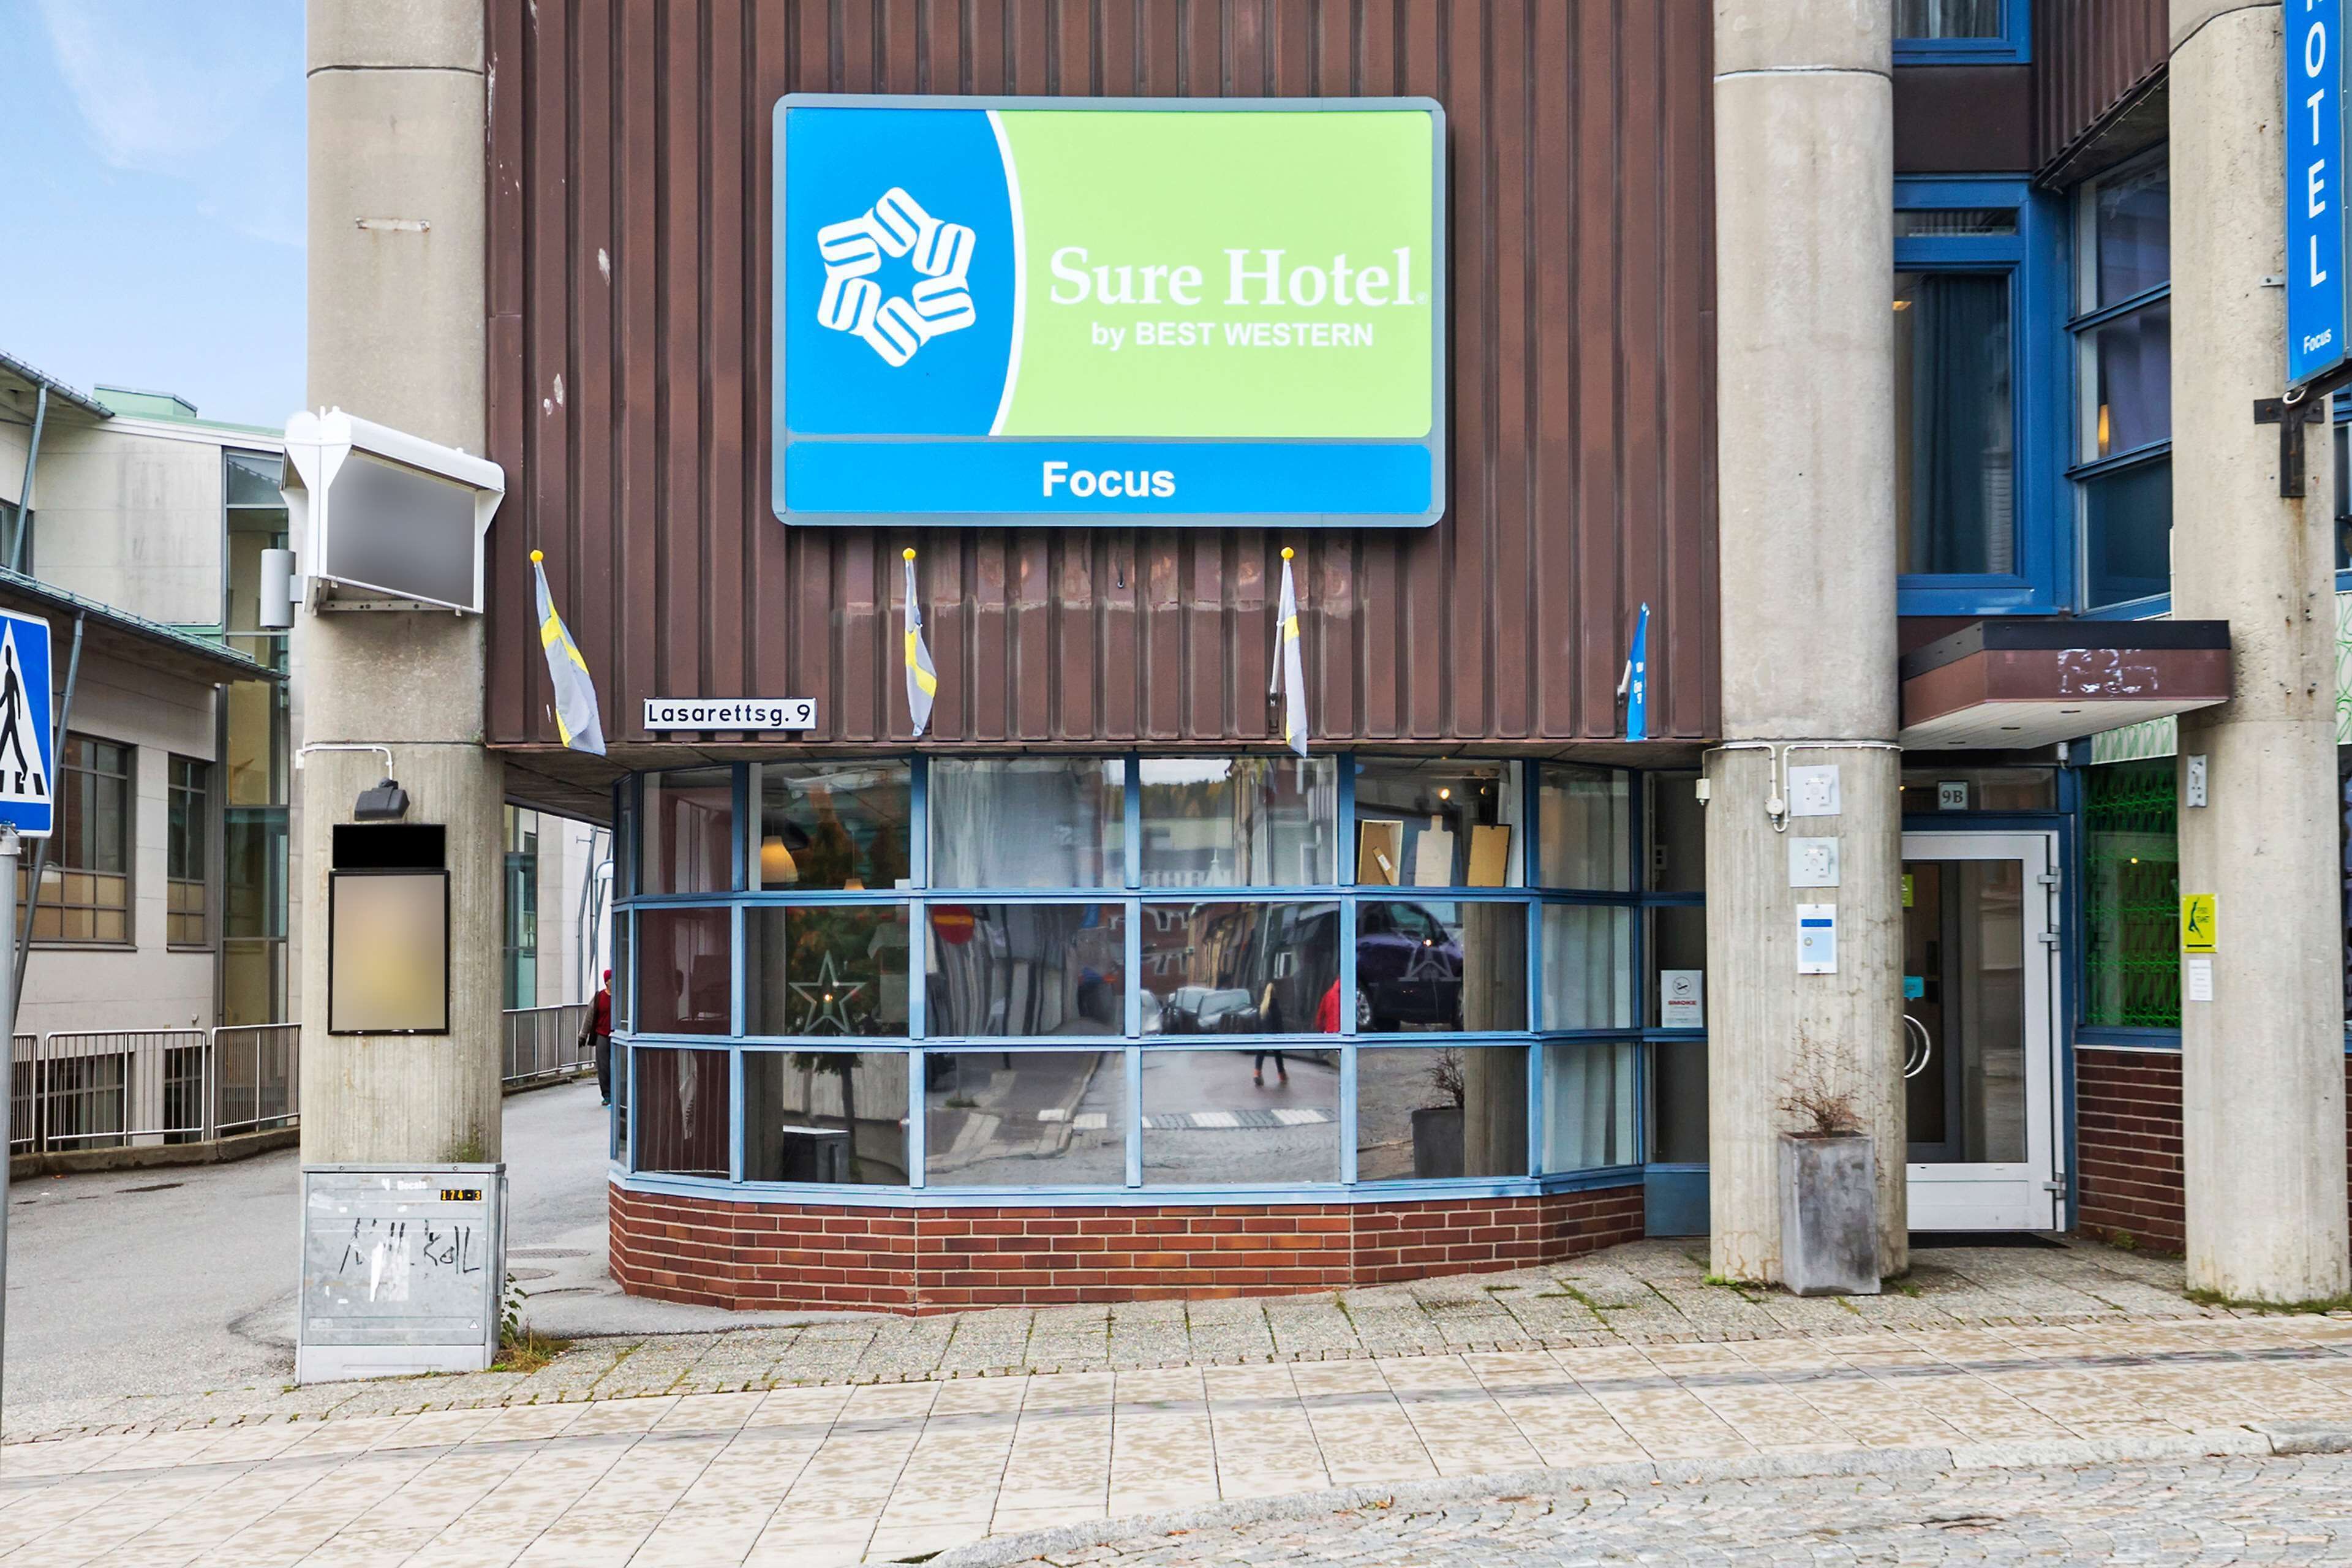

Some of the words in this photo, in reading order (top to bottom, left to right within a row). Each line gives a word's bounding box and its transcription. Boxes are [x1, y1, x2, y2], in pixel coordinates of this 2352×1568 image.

[1050, 247, 1203, 306] Sure
[1224, 246, 1415, 307] Hotel
[1091, 322, 1125, 352] by
[1136, 322, 1216, 347] BEST
[1224, 322, 1373, 347] WESTERN
[2304, 328, 2332, 354] Focus
[1043, 461, 1175, 497] Focus
[649, 704, 789, 727] Lasarettsg.
[797, 704, 810, 722] 9
[1942, 790, 1964, 804] 9B
